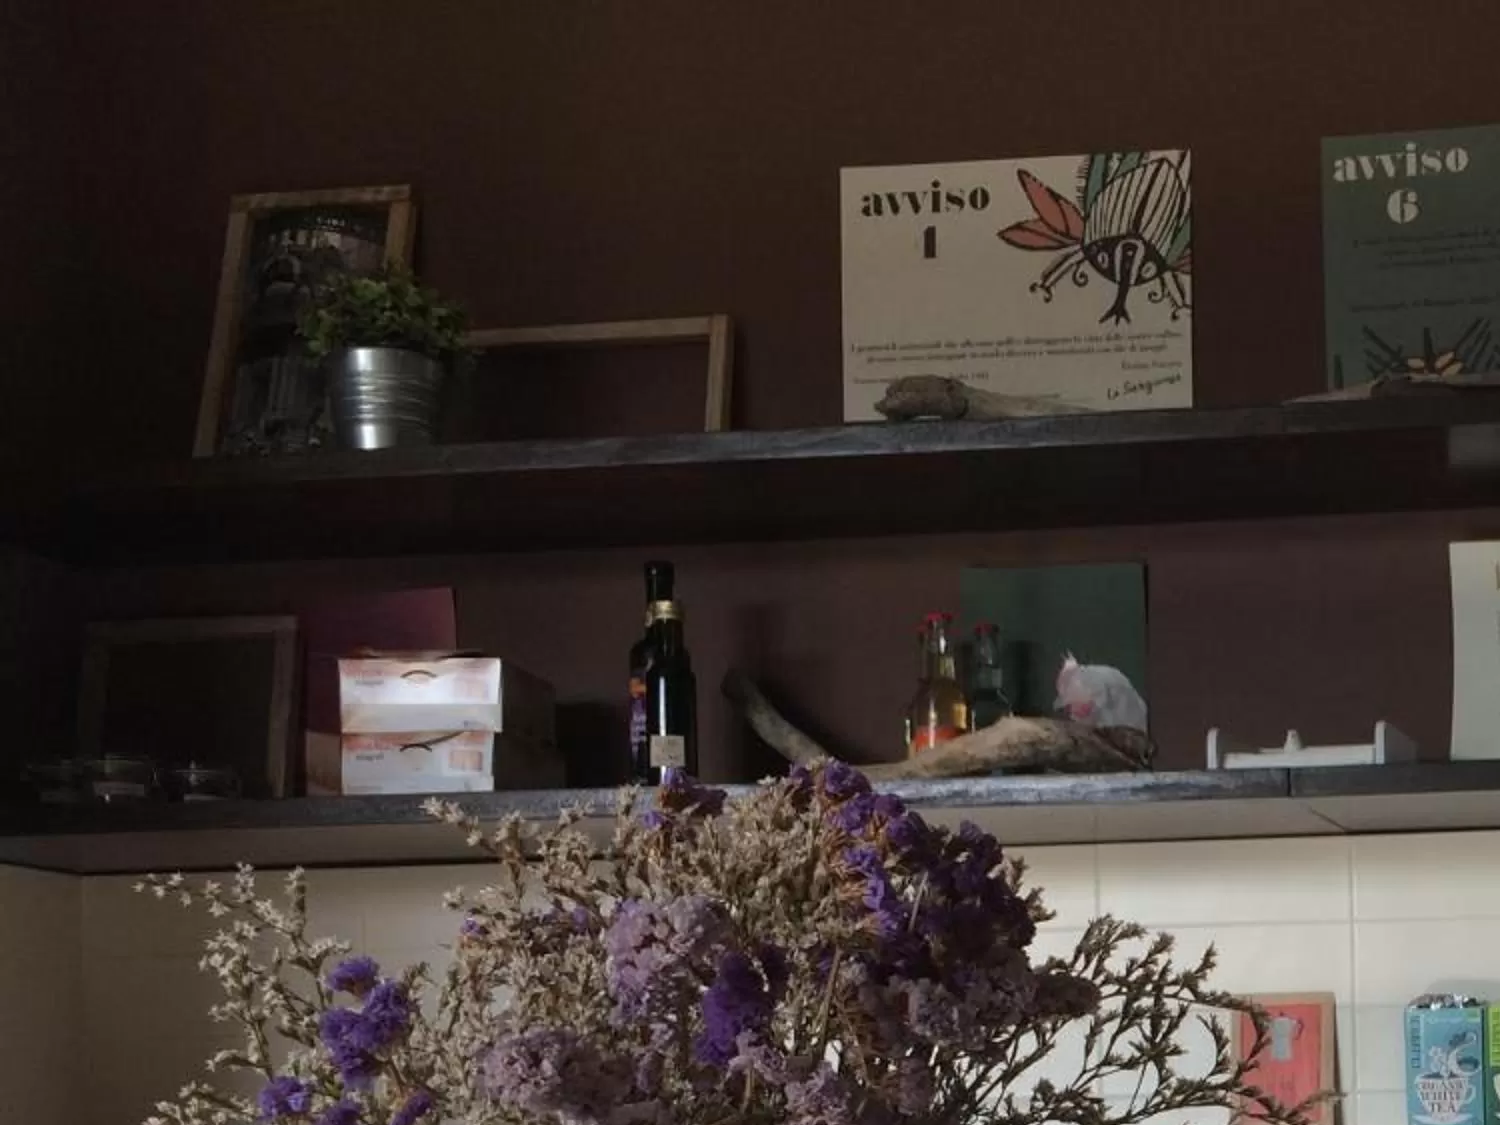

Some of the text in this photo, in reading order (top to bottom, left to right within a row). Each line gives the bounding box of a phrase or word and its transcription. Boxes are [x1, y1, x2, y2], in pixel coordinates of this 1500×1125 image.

[1333, 141, 1470, 182] avviso
[861, 179, 991, 217] avviso
[1386, 188, 1420, 224] 6
